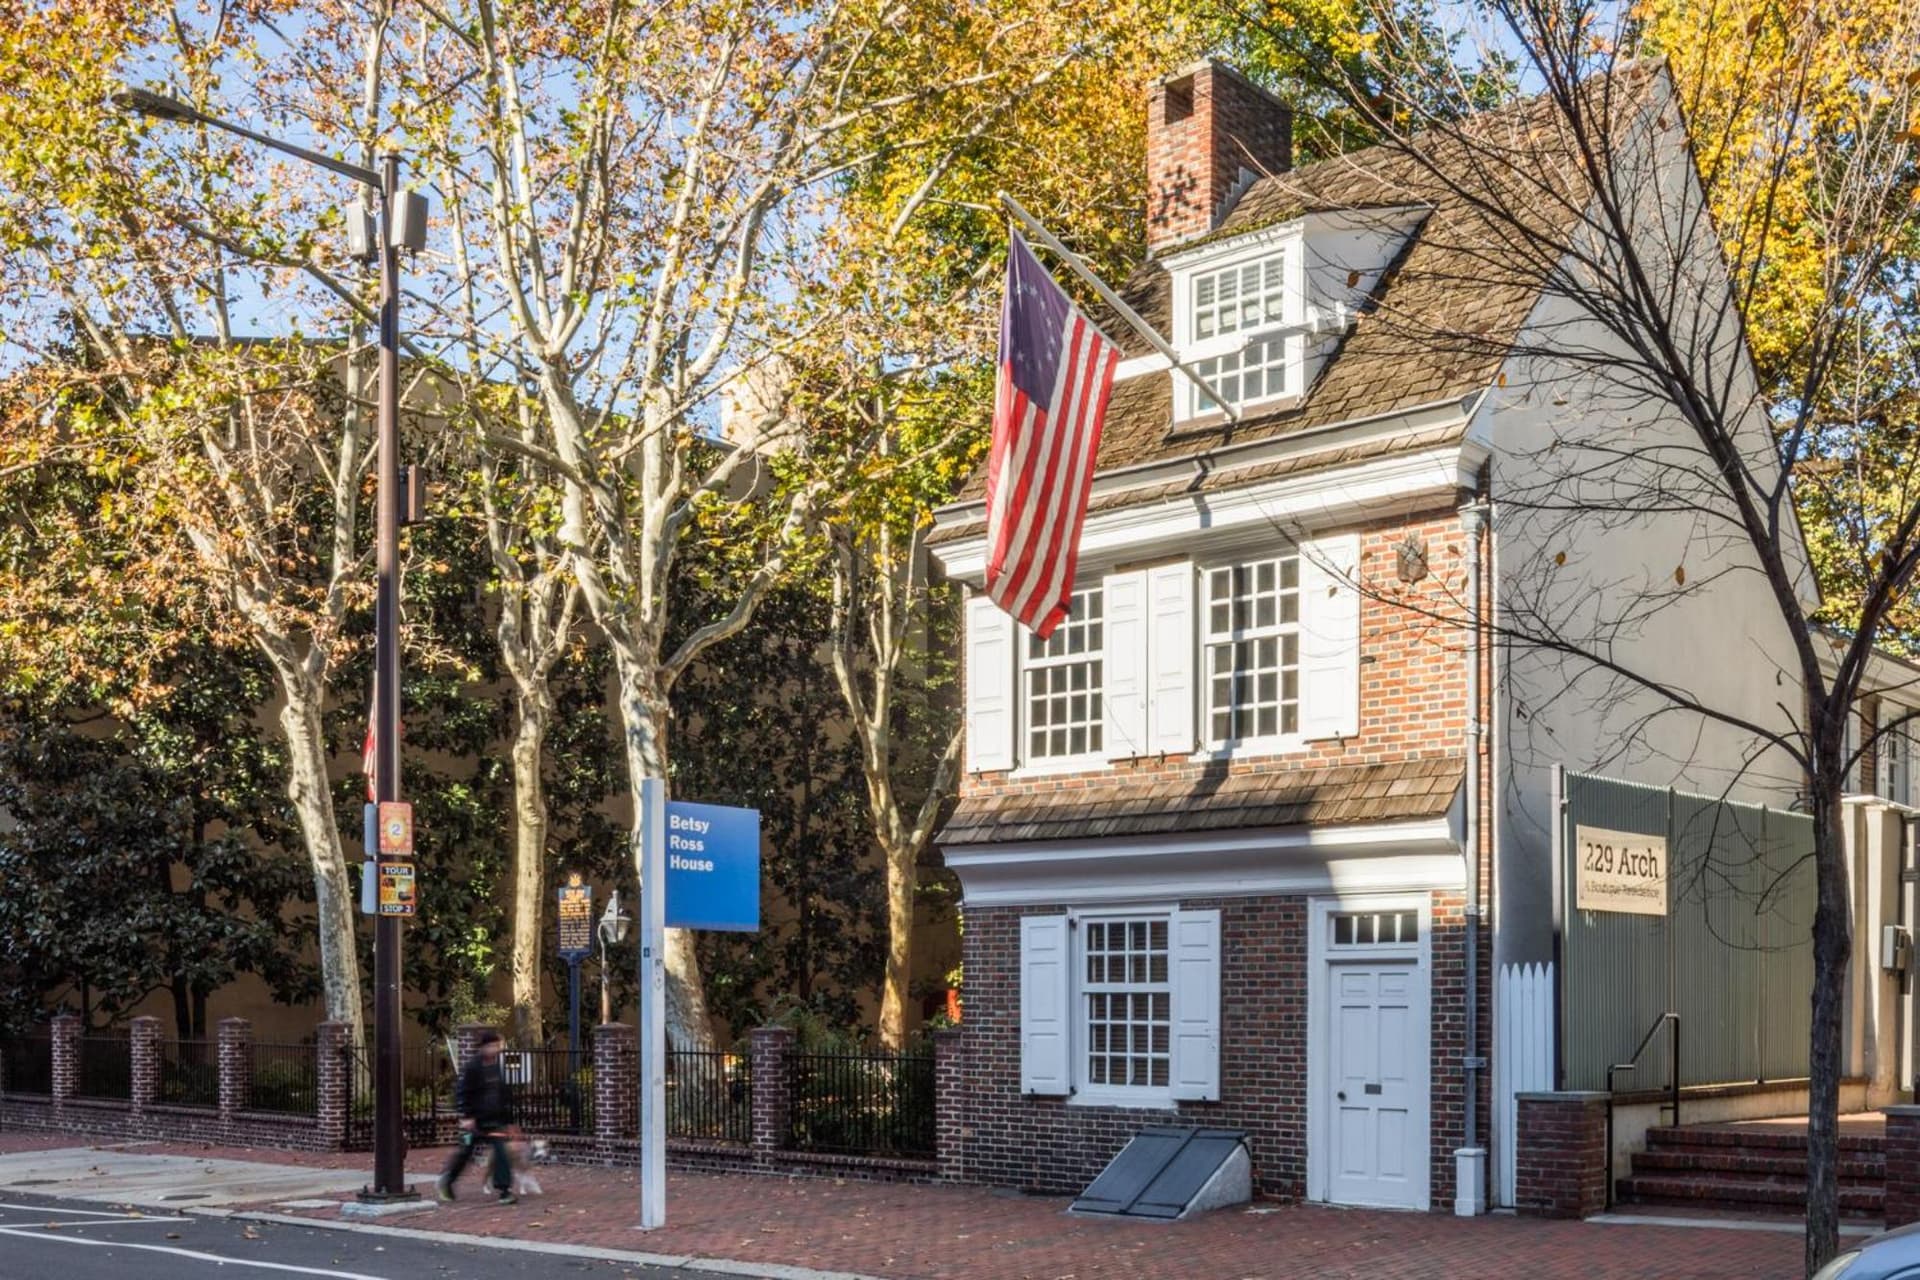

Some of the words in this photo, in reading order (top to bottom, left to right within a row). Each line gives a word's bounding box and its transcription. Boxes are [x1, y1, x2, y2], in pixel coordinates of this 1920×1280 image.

[391, 823, 401, 836] 2
[670, 815, 710, 835] Betsy
[670, 835, 704, 851] Ross
[670, 854, 714, 872] House
[1585, 842, 1613, 874] 229
[1618, 847, 1659, 879] Arch
[385, 867, 409, 876] TOUR
[384, 904, 403, 913] STOP
